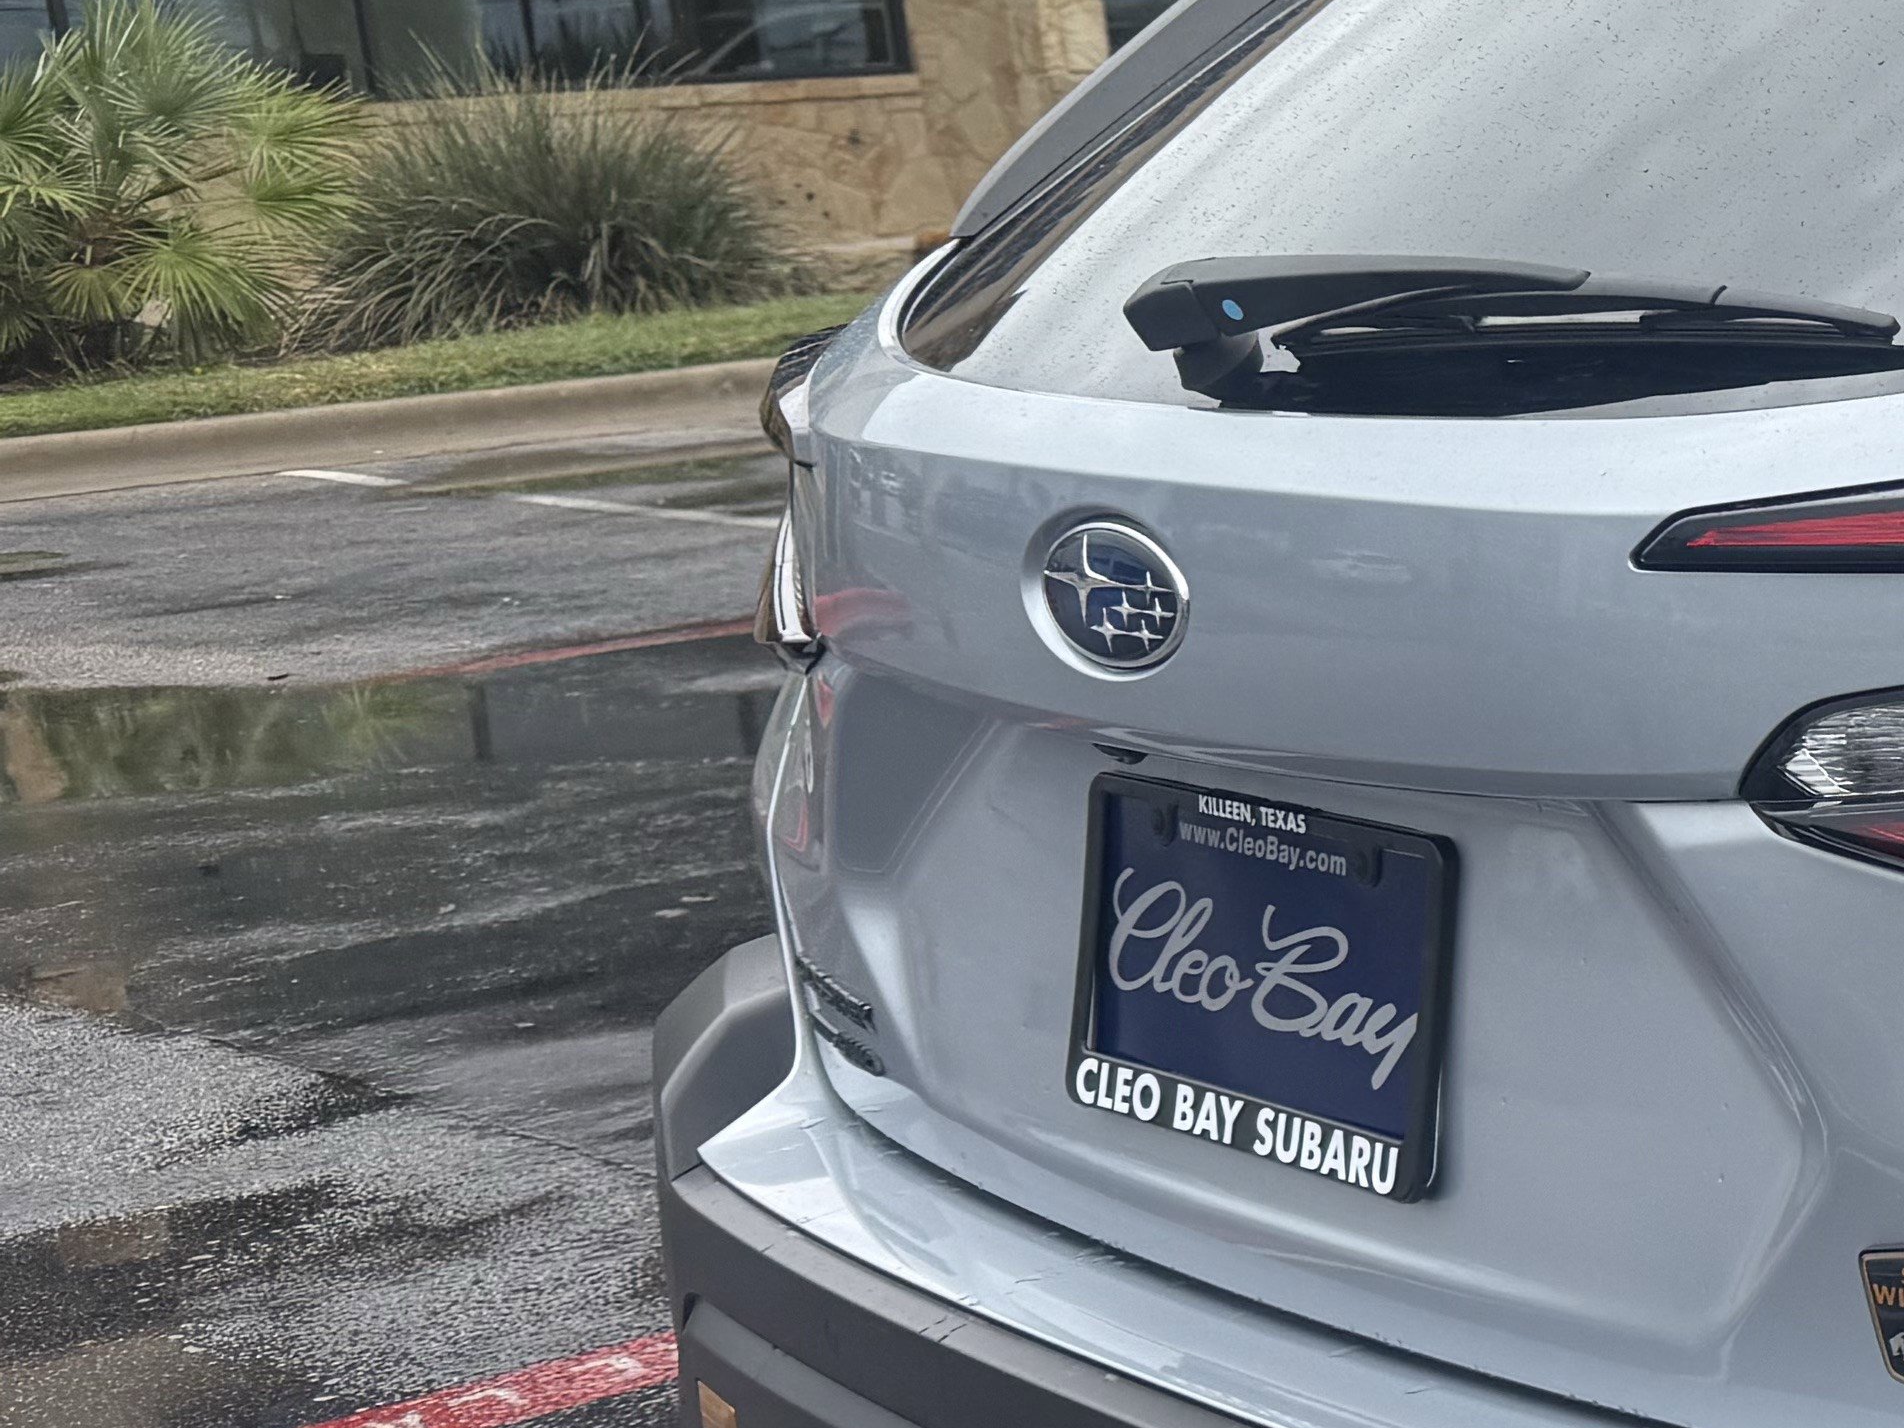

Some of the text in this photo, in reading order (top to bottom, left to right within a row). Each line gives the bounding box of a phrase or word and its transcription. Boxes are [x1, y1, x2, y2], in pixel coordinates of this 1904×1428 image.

[1178, 819, 1348, 877] www.CleoBay.com
[1198, 793, 1307, 835] KILLEEN, TEXAS
[1108, 866, 1419, 1091] Cleo Bay
[1075, 1057, 1400, 1195] CLEO BAY SUBARU
